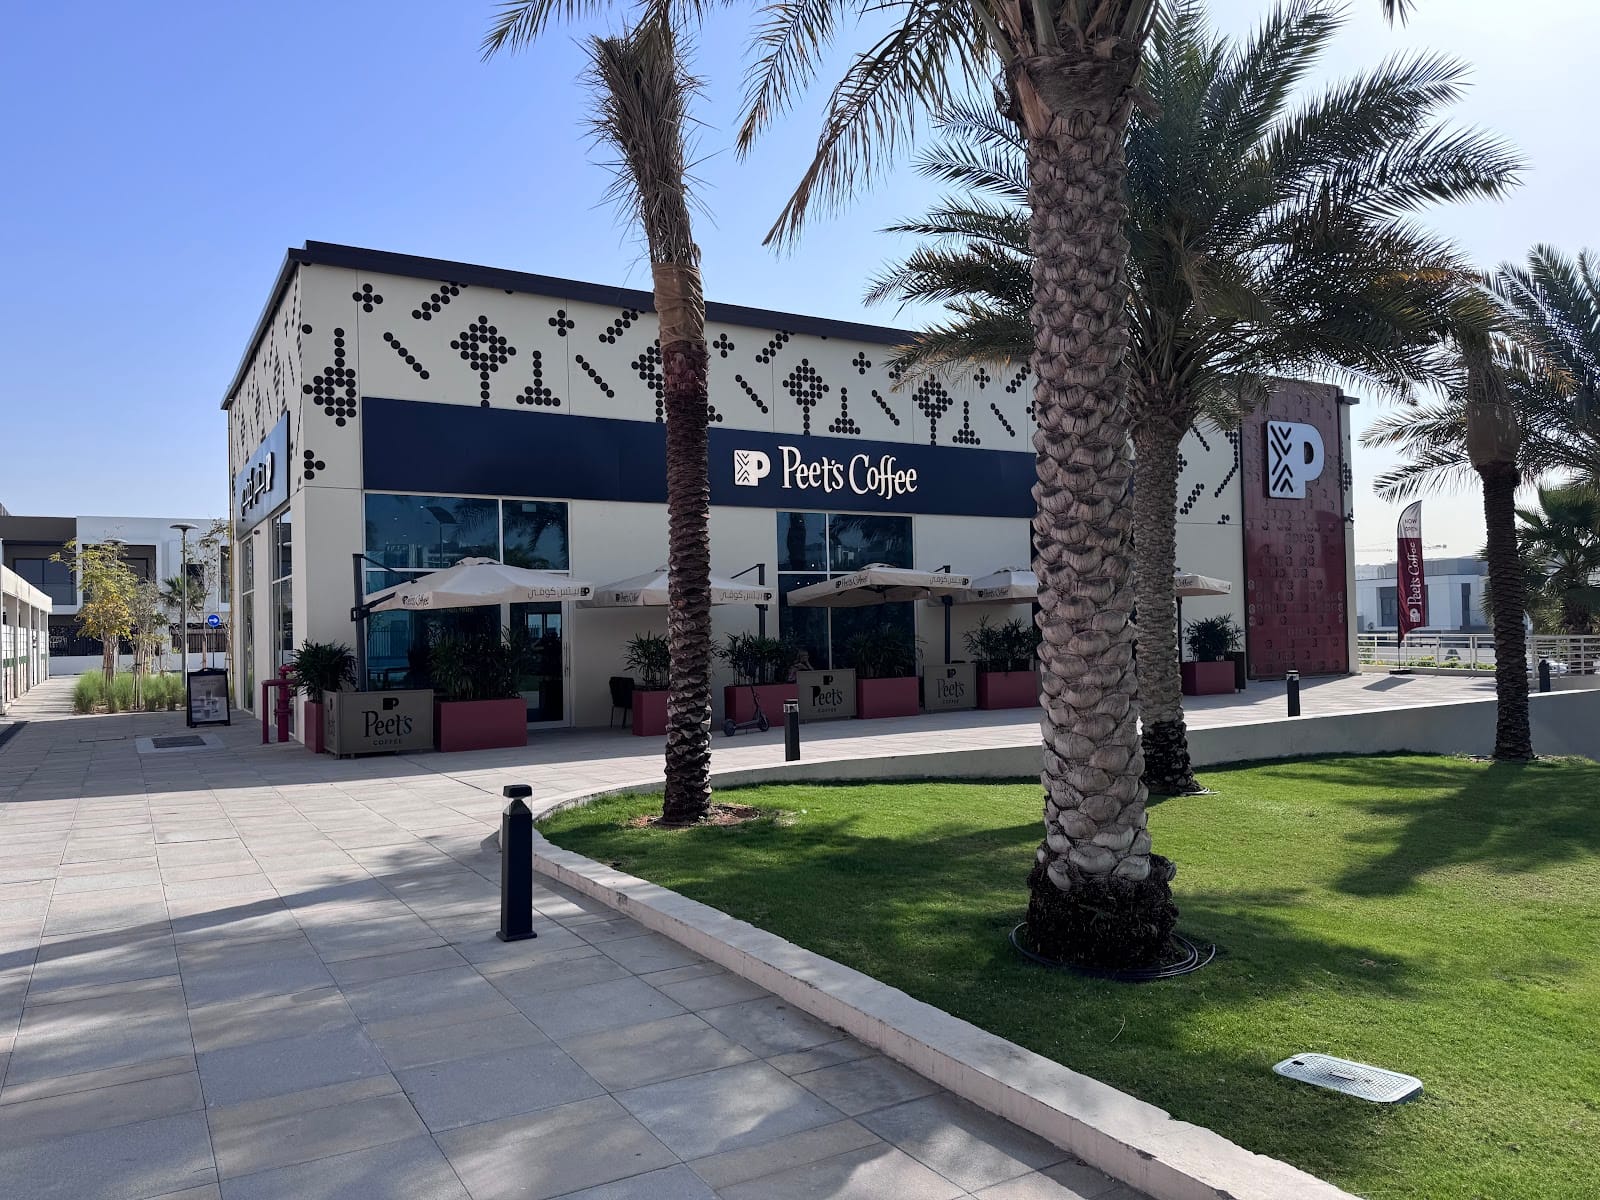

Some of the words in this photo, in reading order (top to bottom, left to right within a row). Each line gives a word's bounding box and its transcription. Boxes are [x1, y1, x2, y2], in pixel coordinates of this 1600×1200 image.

[778, 445, 844, 493] Peet's
[849, 453, 918, 500] Coffee
[1407, 541, 1420, 576] Coffee
[1407, 577, 1422, 605] Peet's
[810, 685, 843, 707] Peet's
[936, 678, 965, 698] Peet's
[361, 710, 413, 737] Peet's
[372, 738, 402, 746] COFFEE
